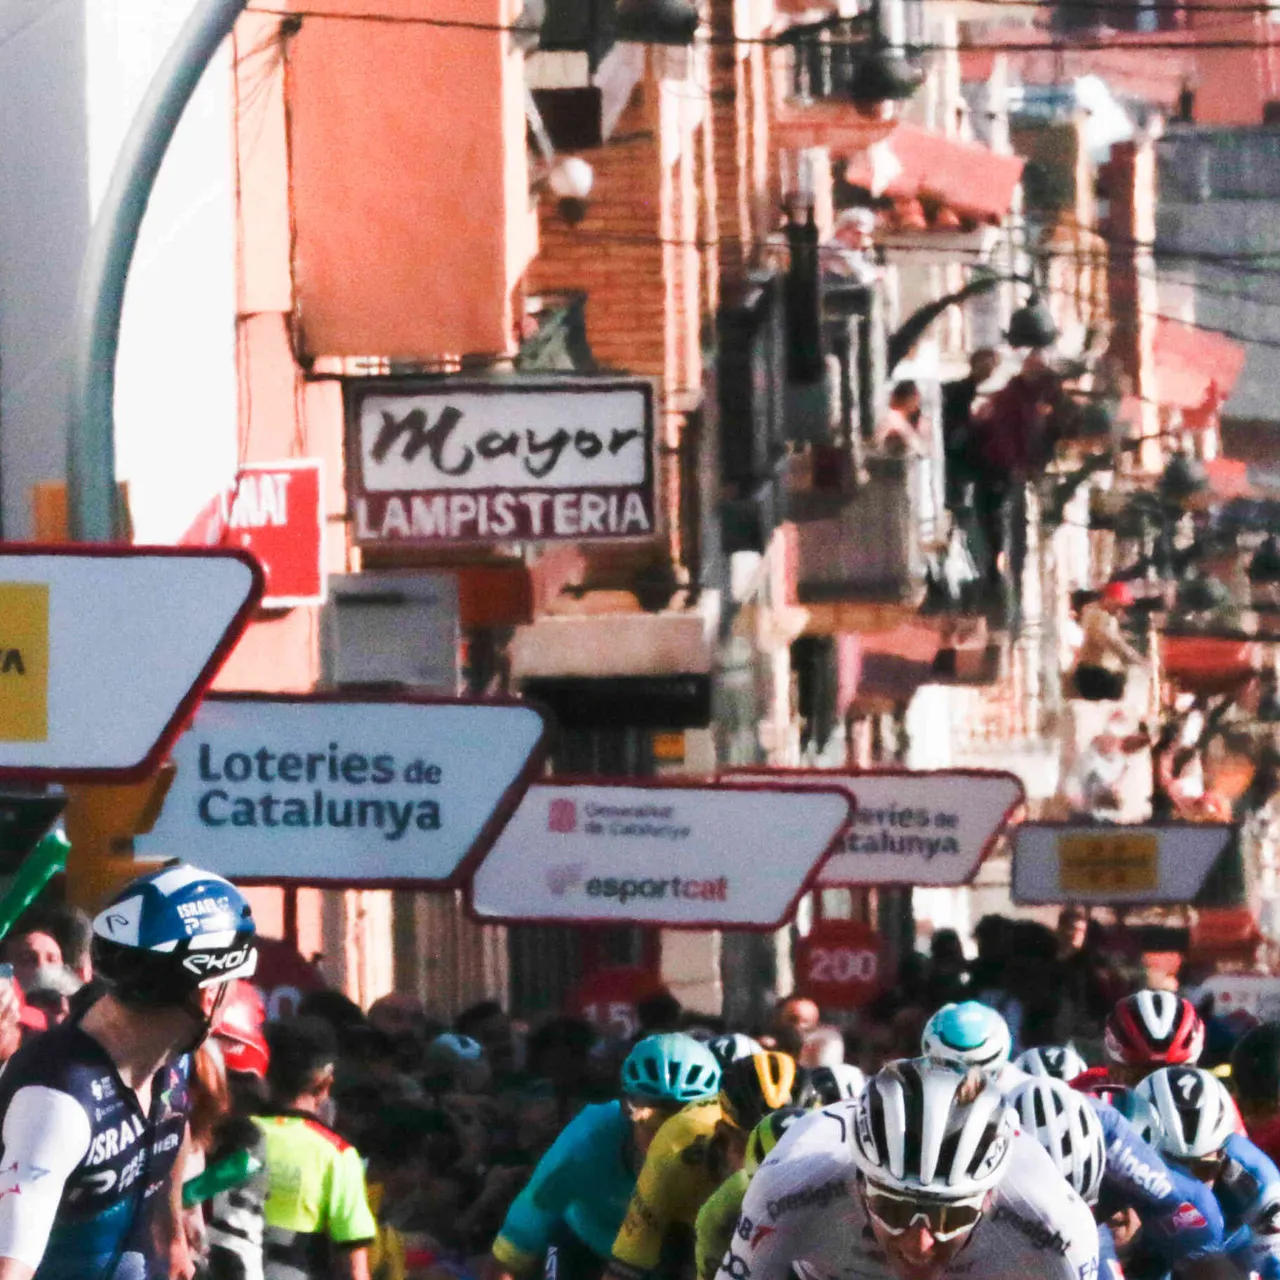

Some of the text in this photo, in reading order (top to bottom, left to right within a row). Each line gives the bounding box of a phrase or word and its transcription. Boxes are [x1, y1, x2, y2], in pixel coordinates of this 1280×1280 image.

[371, 405, 641, 479] Mayor
[354, 493, 649, 540] LAMPISTERIA
[198, 742, 442, 785] Loteries de
[198, 788, 442, 841] Catalunya
[586, 876, 728, 904] esportcat
[809, 947, 877, 983] 200
